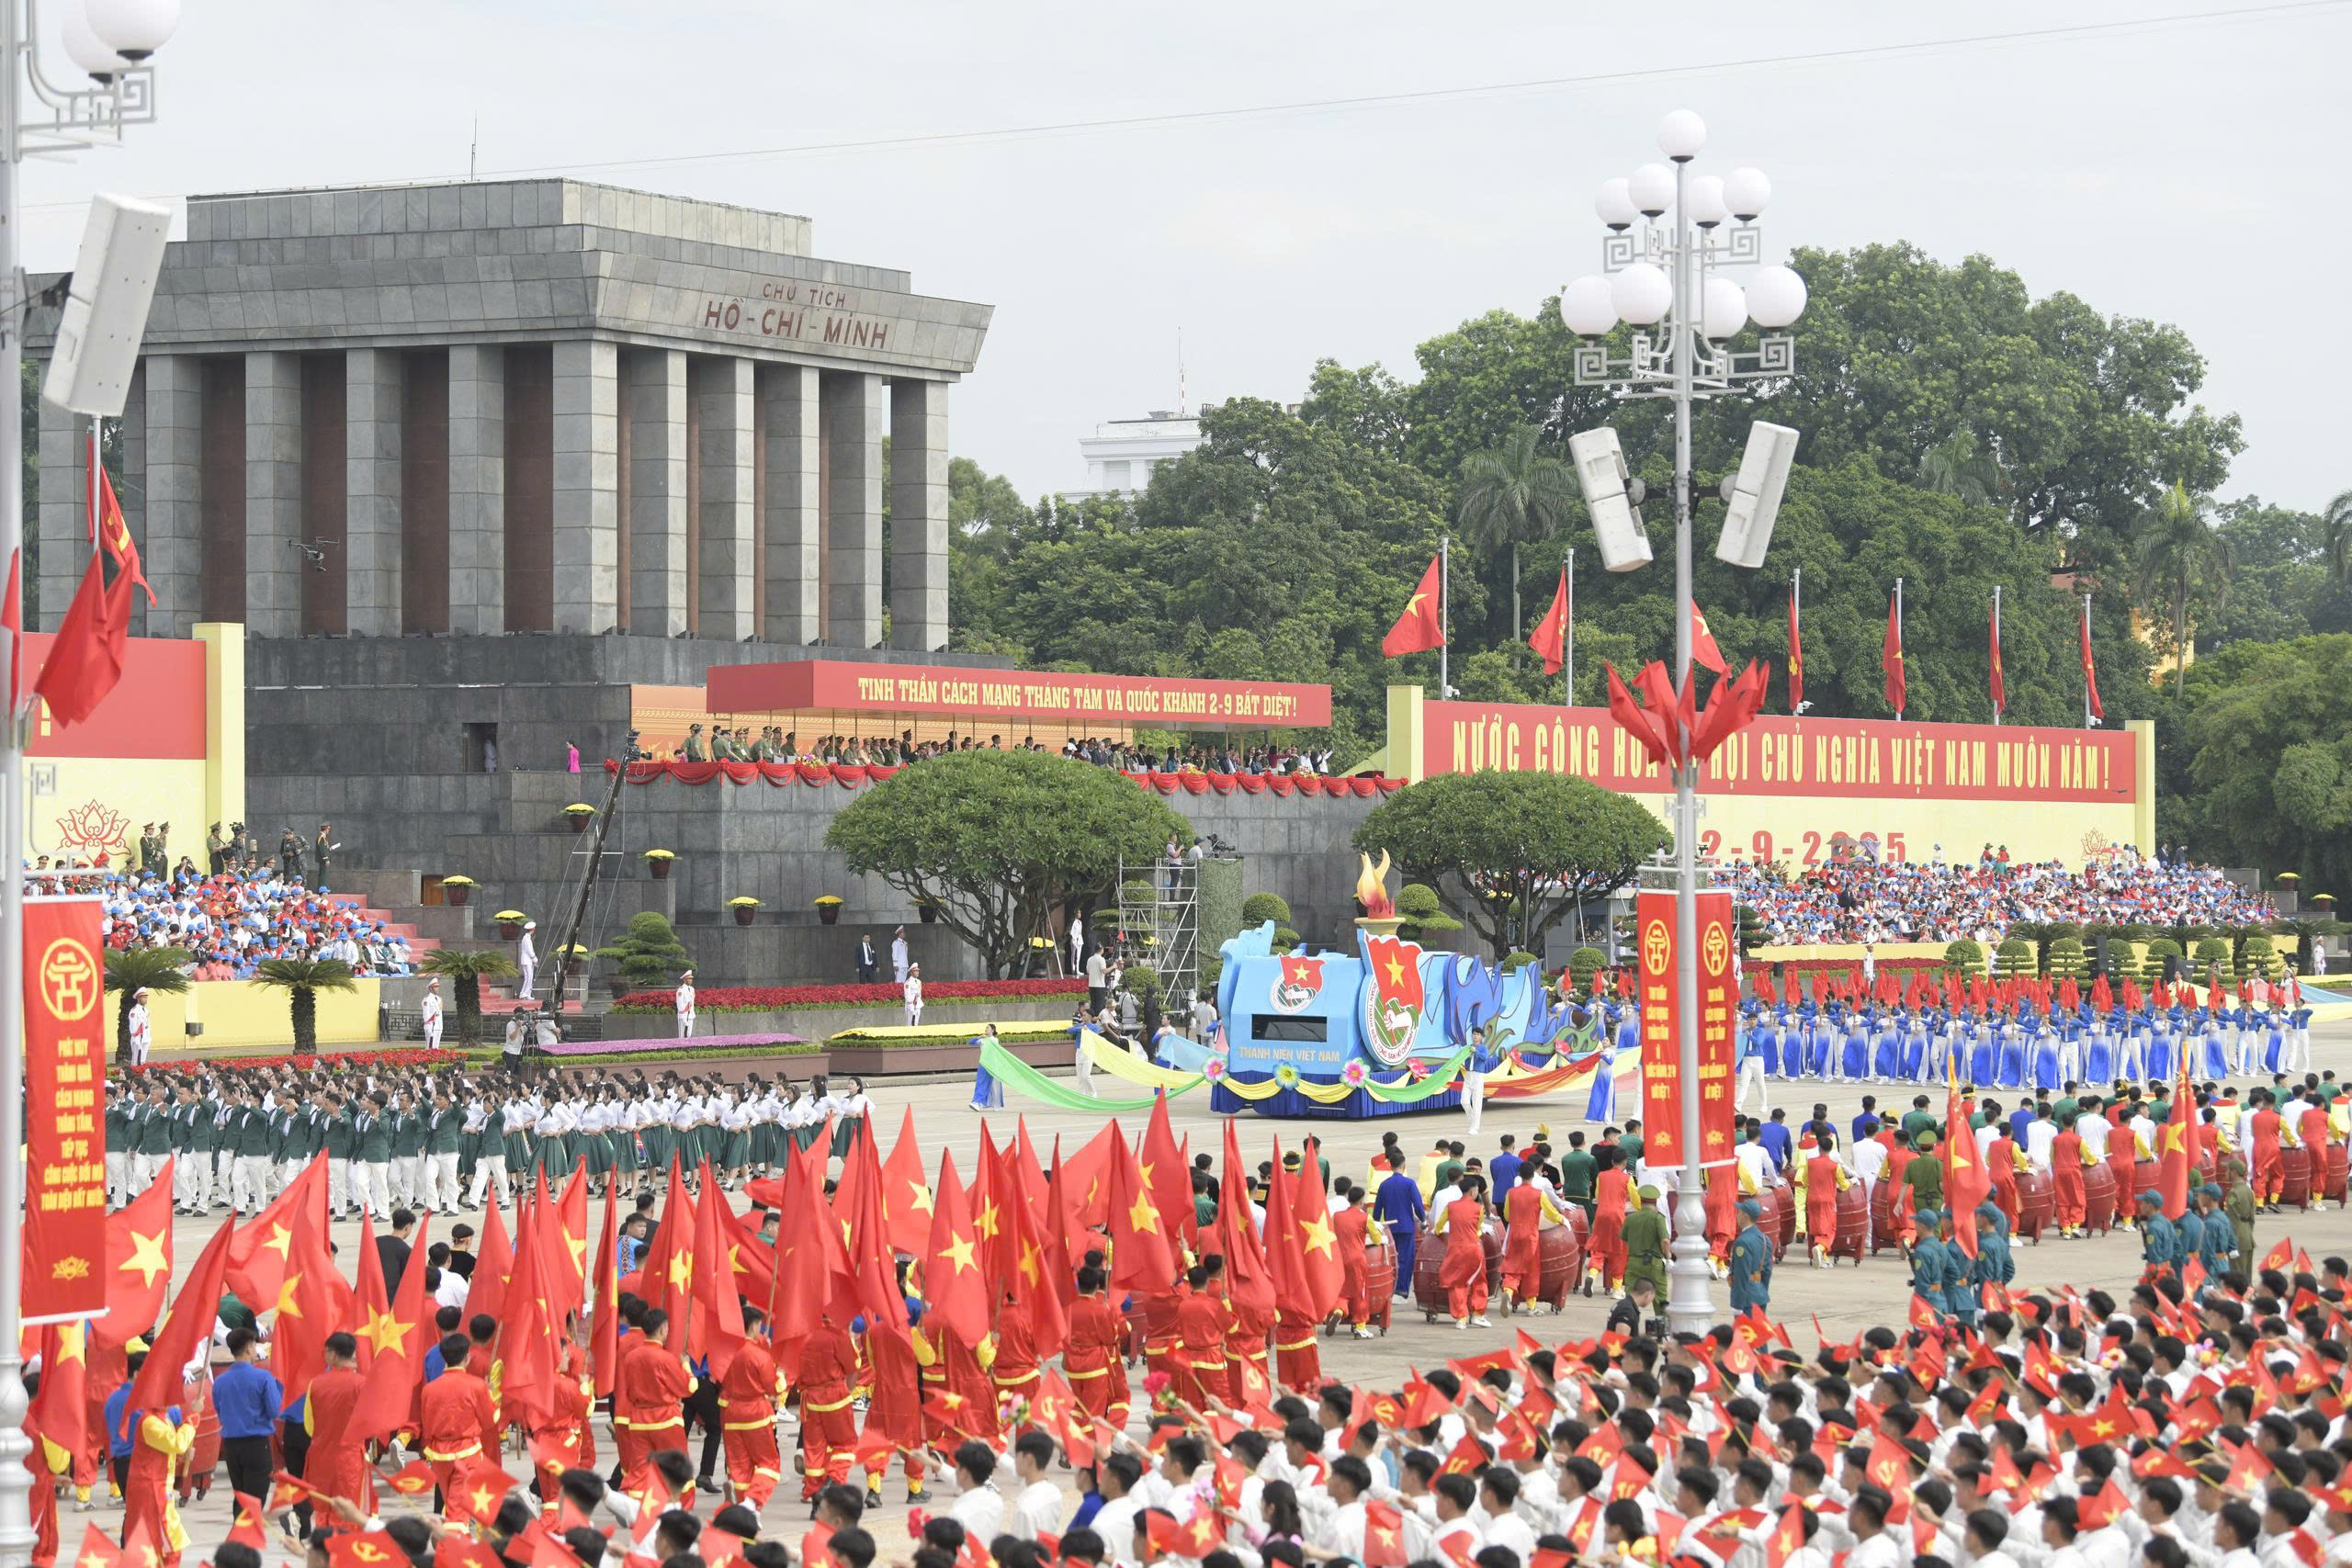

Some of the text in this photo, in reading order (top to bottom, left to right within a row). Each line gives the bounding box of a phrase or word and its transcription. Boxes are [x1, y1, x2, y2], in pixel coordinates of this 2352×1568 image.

[858, 677, 895, 702] TINH
[899, 672, 938, 704] THẦN
[942, 676, 978, 705] CÁCH
[982, 682, 1021, 710] MẠNG
[1024, 682, 1069, 708] THÁNG
[1073, 683, 1102, 710] TÁM
[1106, 685, 1123, 711] VÀ
[1126, 683, 1159, 713] QUỐC
[1163, 687, 1206, 714] KHÁNH
[1209, 693, 1232, 715] 2-9
[1236, 688, 1260, 716] BẤT
[1453, 713, 1520, 773] NƯỚC
[1761, 722, 1804, 783] CHỦ
[1816, 729, 1881, 784] NGHĨA
[1891, 731, 1935, 794] VIỆT
[1945, 739, 1985, 787] NAM
[1996, 735, 2050, 789] MUÔN
[1239, 1046, 1270, 1059] THANH
[1272, 1046, 1294, 1060] NIÊN
[1318, 1050, 1340, 1062] NAM
